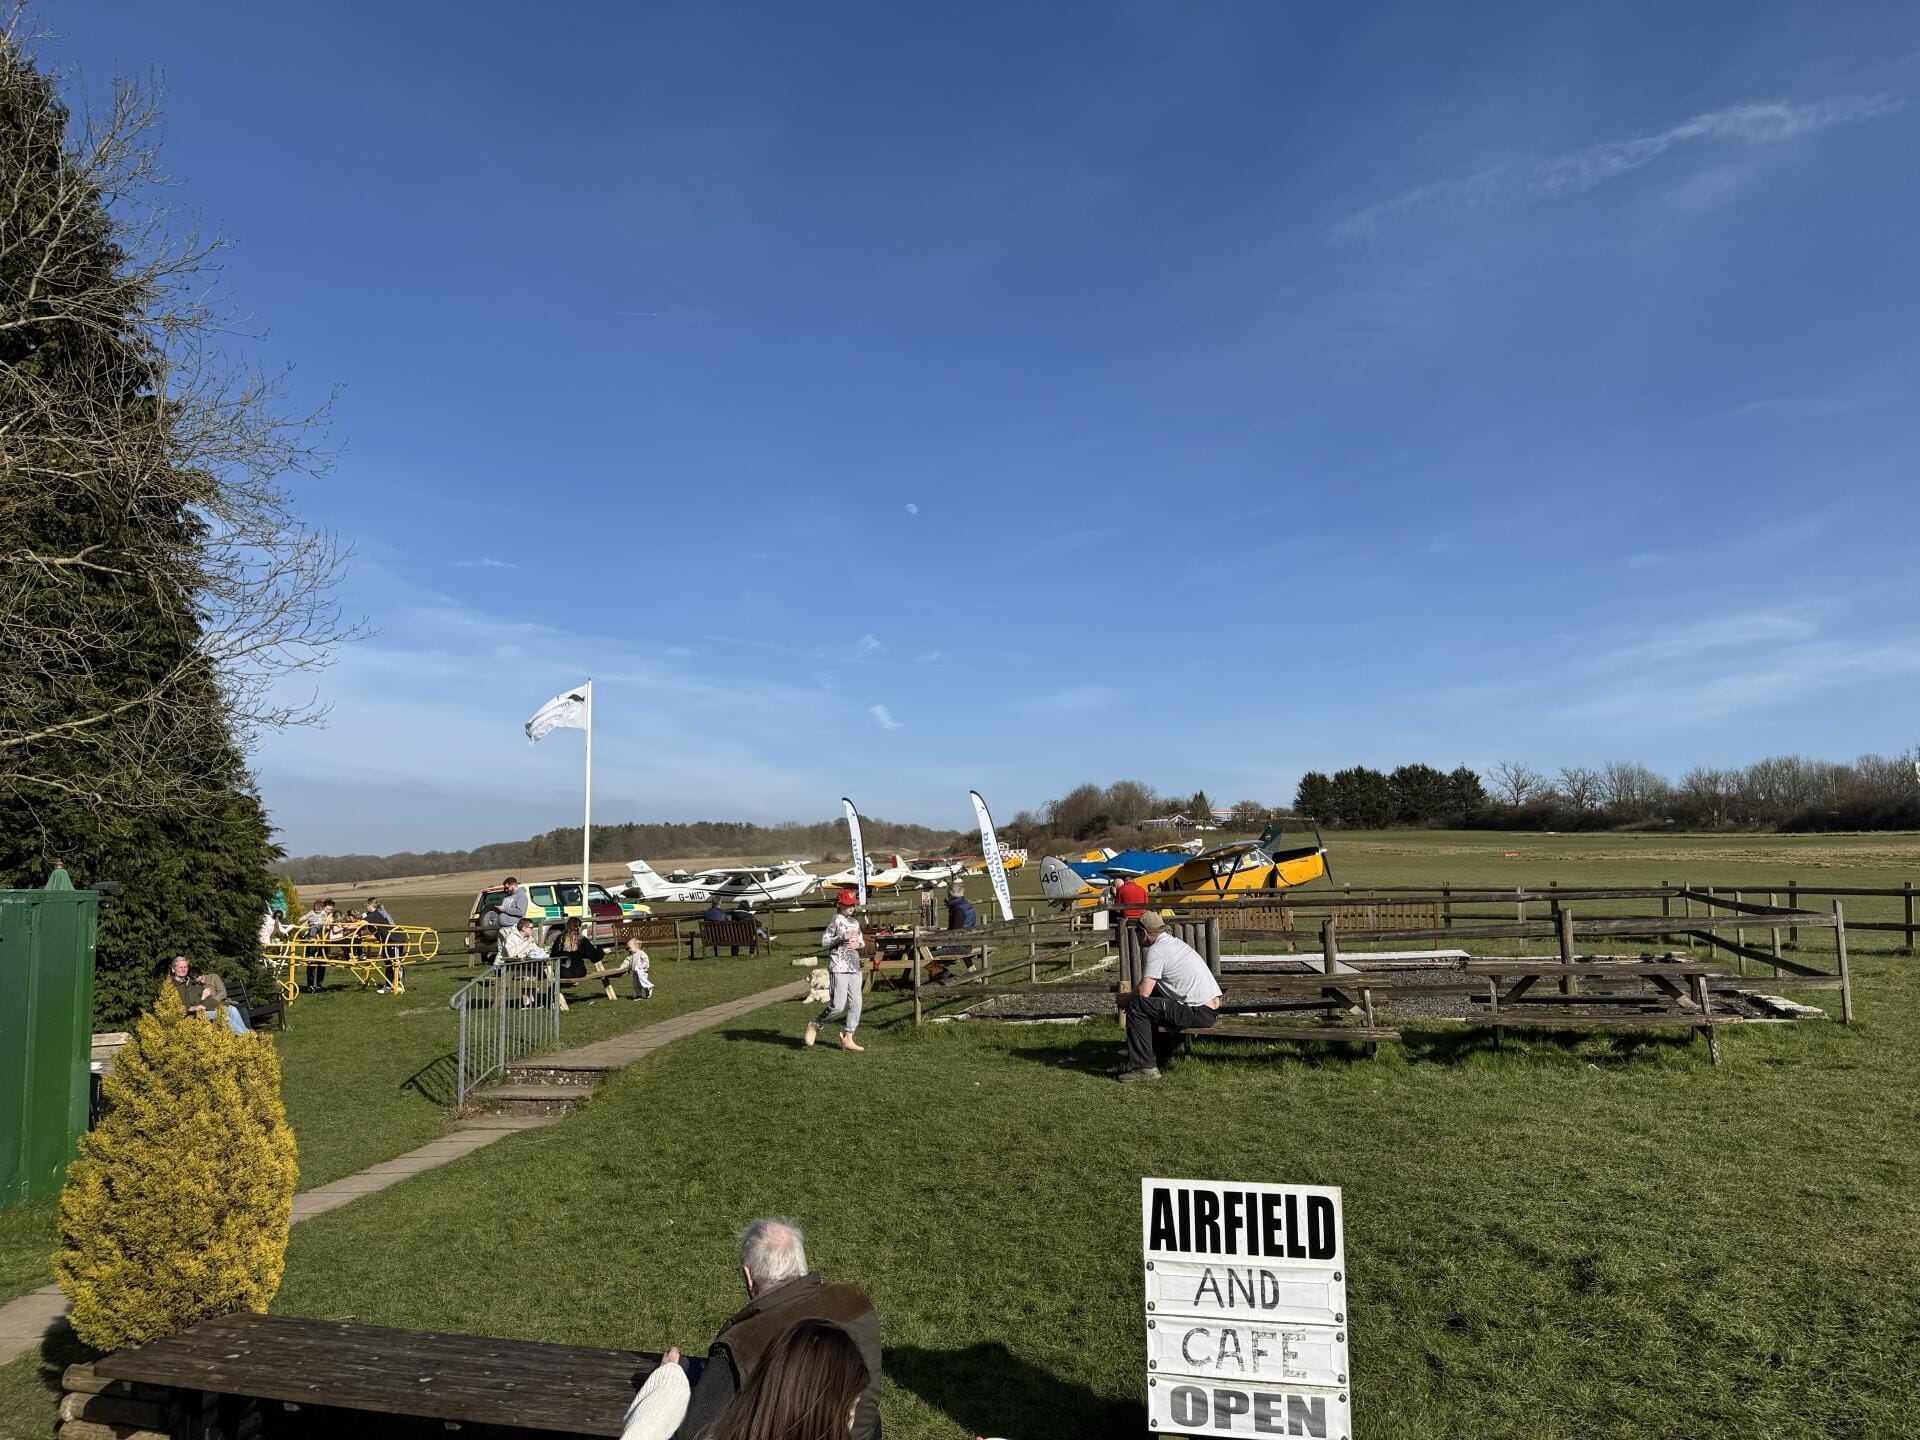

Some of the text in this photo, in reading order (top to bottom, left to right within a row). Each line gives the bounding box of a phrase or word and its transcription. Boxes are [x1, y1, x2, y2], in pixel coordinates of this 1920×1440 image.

[678, 890, 705, 902] G-MICI
[1041, 871, 1059, 884] 46
[1149, 1188, 1336, 1260] AIRFIELD
[1194, 1267, 1280, 1310] AND
[1182, 1327, 1307, 1379] CAFE
[1169, 1385, 1327, 1439] OPEN
